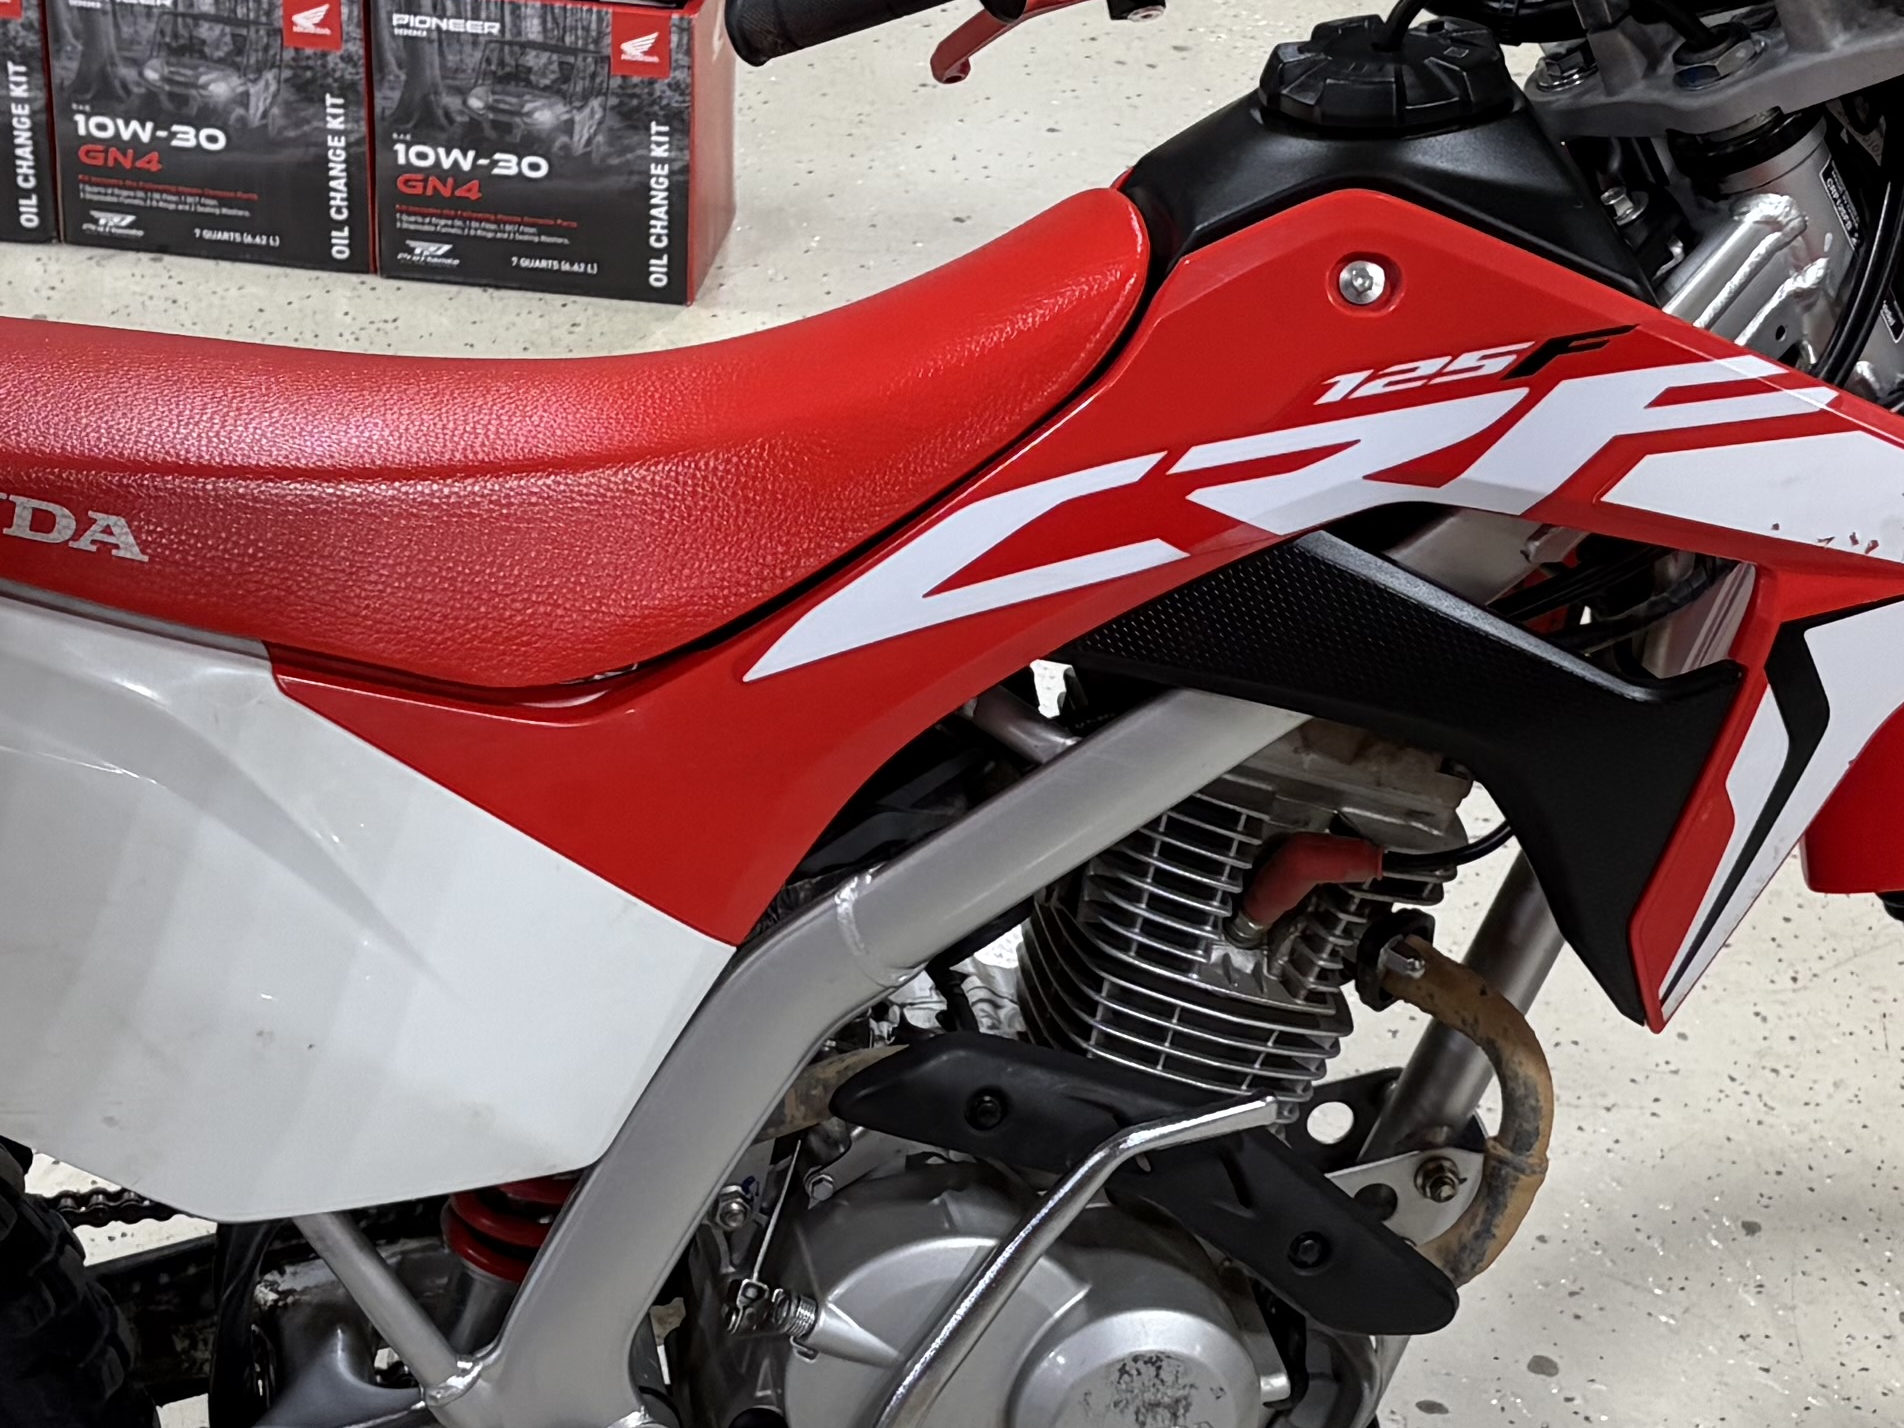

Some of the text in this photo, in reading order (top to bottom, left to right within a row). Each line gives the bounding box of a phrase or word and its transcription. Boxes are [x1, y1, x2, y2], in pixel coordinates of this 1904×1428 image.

[392, 13, 501, 35] PIONEER
[7, 60, 40, 229] OIL CHANGE KIT
[73, 113, 227, 151] 10W-30
[77, 144, 162, 172] GN4
[325, 93, 350, 260] OIL CHANGE KIT
[392, 143, 549, 179] 10W-30
[396, 173, 483, 201] GN4
[648, 121, 670, 288] OIL CHANGE KIT
[520, 258, 559, 272] QUARTS
[1312, 325, 1641, 405] 125F
